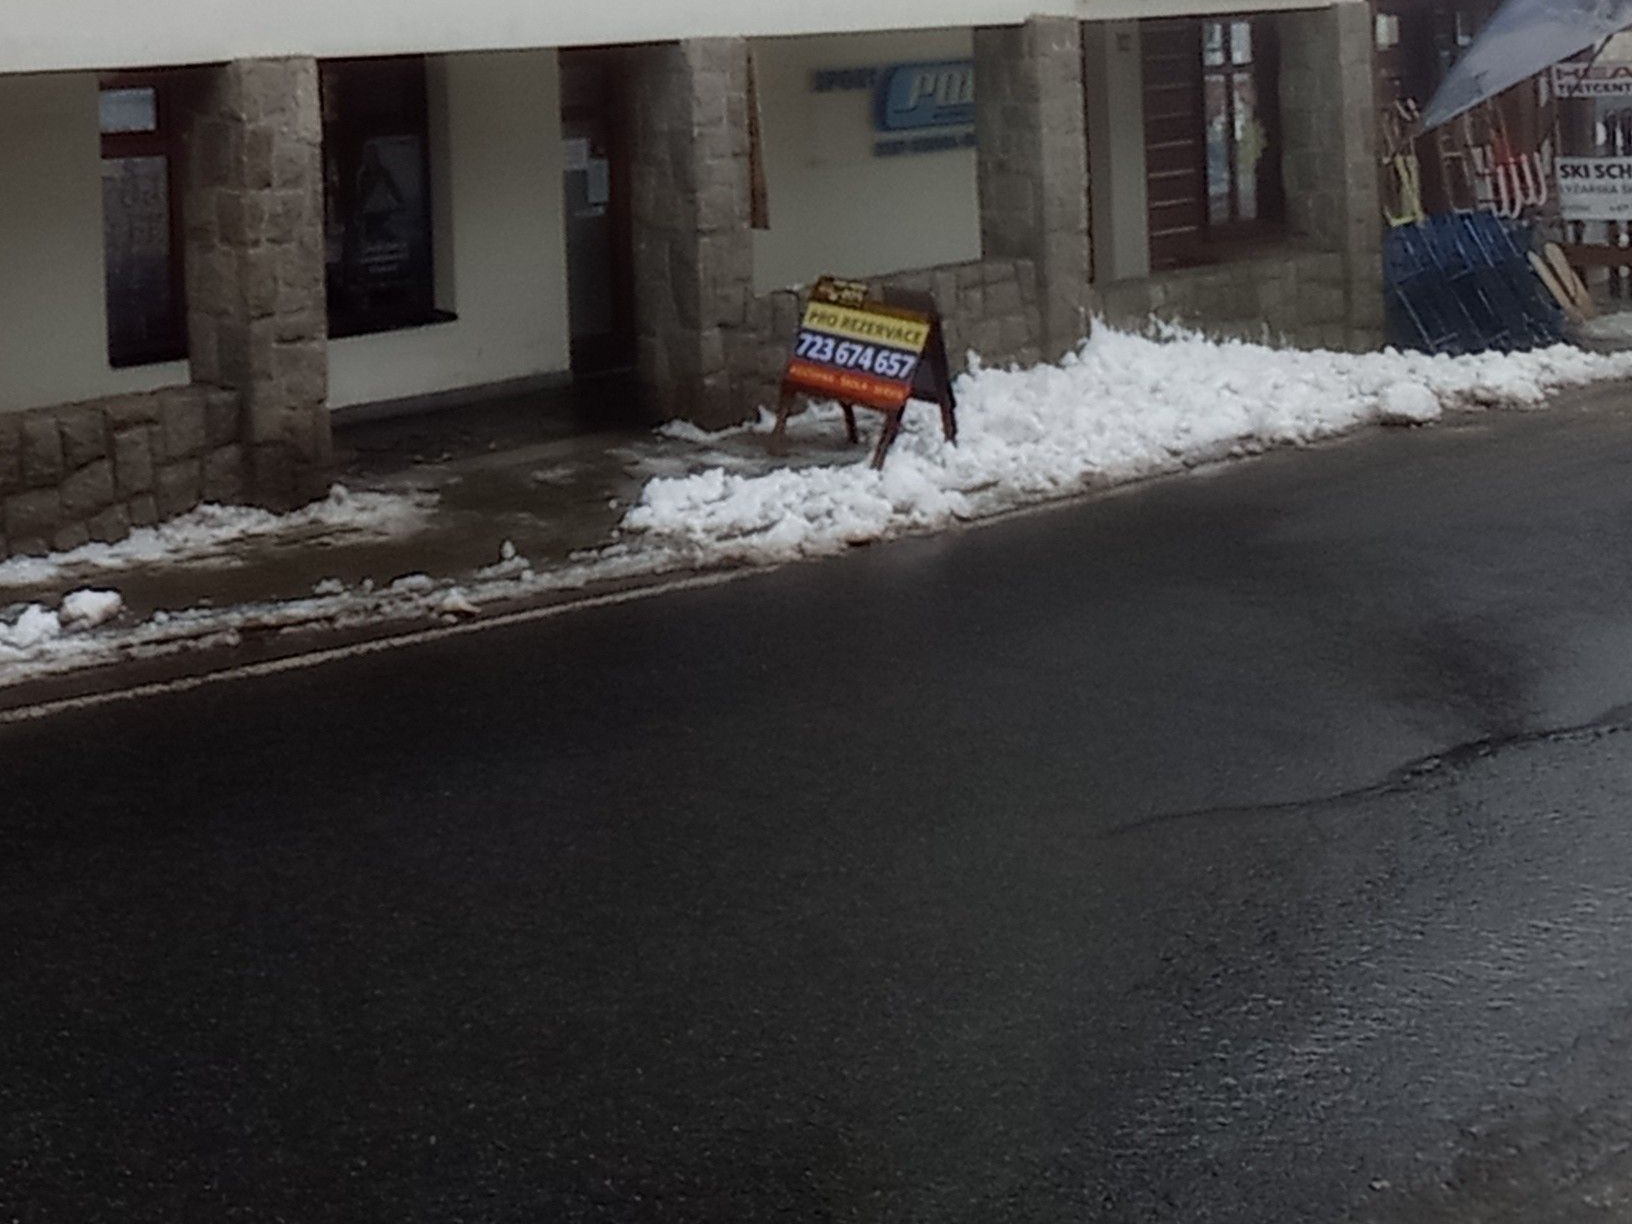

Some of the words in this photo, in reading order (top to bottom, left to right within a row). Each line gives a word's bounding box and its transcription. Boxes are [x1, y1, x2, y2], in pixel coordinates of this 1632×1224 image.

[1559, 163, 1590, 179] SKI
[796, 332, 834, 361] 723
[835, 341, 874, 370] 674
[874, 350, 917, 378] 657
